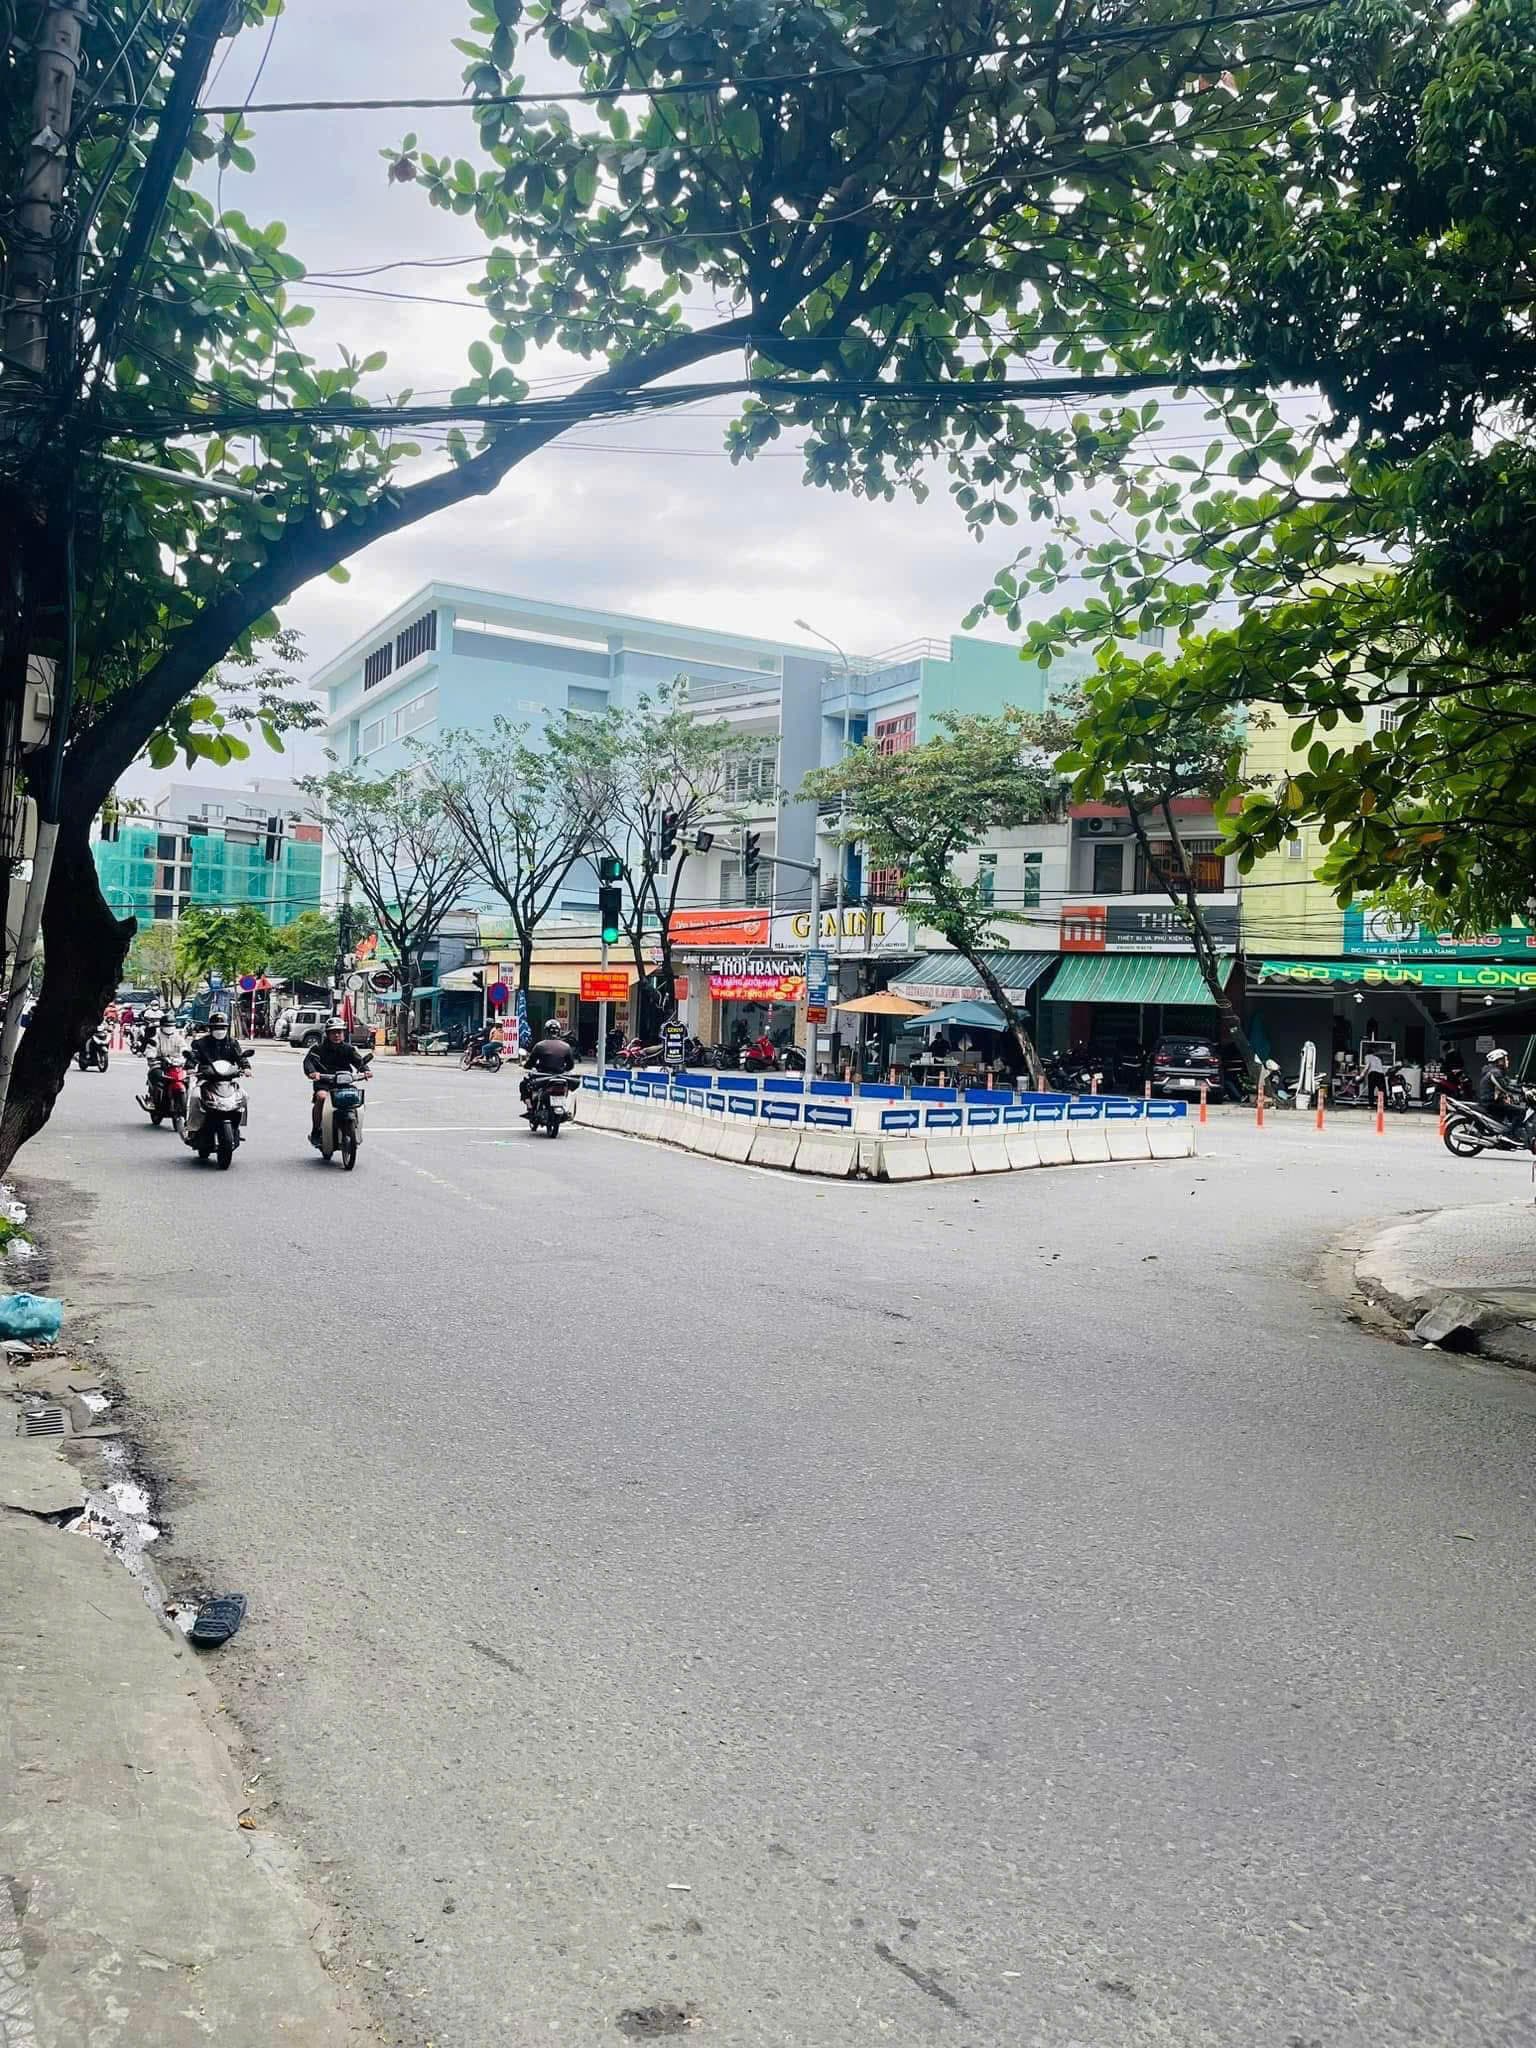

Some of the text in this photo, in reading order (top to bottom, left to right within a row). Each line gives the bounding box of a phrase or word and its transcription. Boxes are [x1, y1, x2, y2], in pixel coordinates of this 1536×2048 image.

[1137, 912, 1204, 932] THỊN
[751, 962, 788, 977] TRANG
[503, 1029, 517, 1041] UỐN
